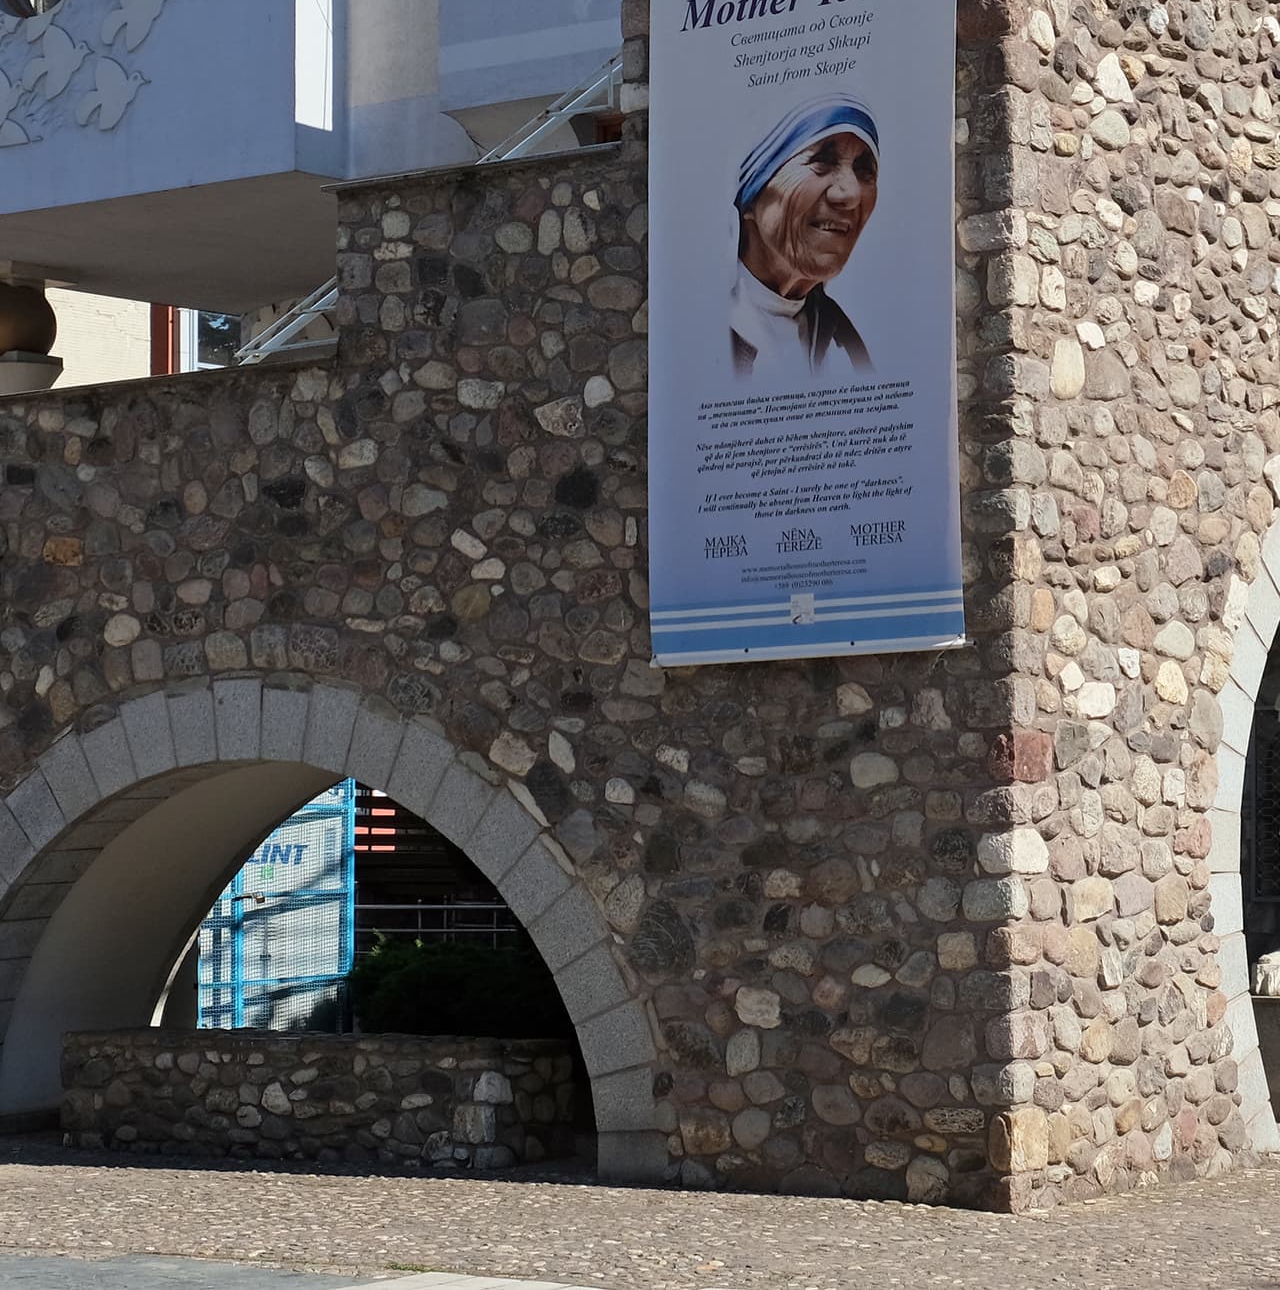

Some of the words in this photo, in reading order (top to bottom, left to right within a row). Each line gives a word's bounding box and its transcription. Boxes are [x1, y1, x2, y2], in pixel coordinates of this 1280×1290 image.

[731, 24, 806, 47] Светицата
[810, 18, 826, 31] од
[830, 12, 874, 29] Скопје
[734, 48, 796, 68] Shenjtorja
[800, 44, 824, 58] nga
[828, 32, 872, 50] Shkupi
[748, 73, 780, 88] Saint
[780, 67, 810, 84] from
[815, 60, 857, 76] Skopje
[769, 488, 789, 496] Saint
[850, 480, 859, 490] of
[793, 496, 810, 506] from
[812, 494, 840, 502] Heaven
[852, 490, 870, 500] light
[872, 489, 884, 497] the
[886, 488, 902, 497] light
[904, 486, 912, 495] of
[850, 520, 906, 535] MOTHER
[853, 532, 903, 546] TERESA
